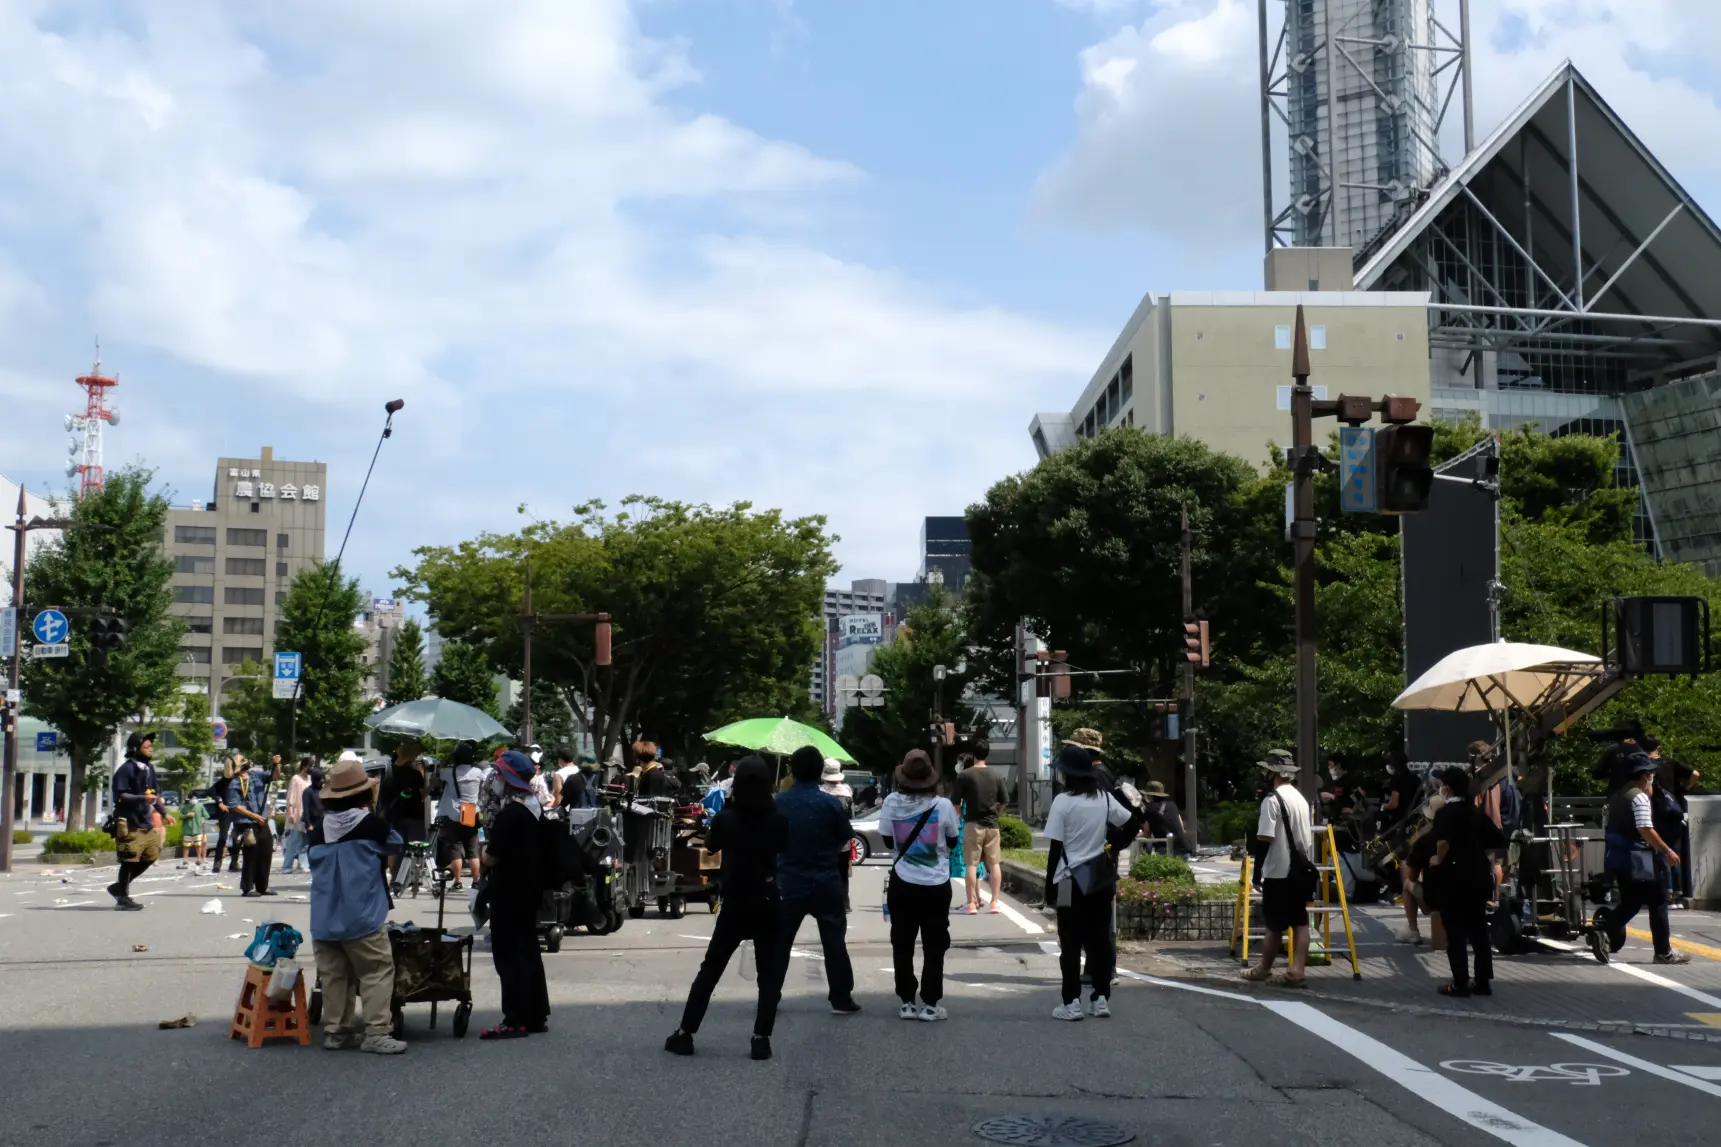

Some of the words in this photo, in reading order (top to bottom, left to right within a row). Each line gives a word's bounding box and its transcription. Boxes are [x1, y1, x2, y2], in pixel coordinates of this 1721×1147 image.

[229, 468, 260, 477] 富山県
[235, 481, 319, 500] 農協会館
[849, 625, 878, 634] RELAX
